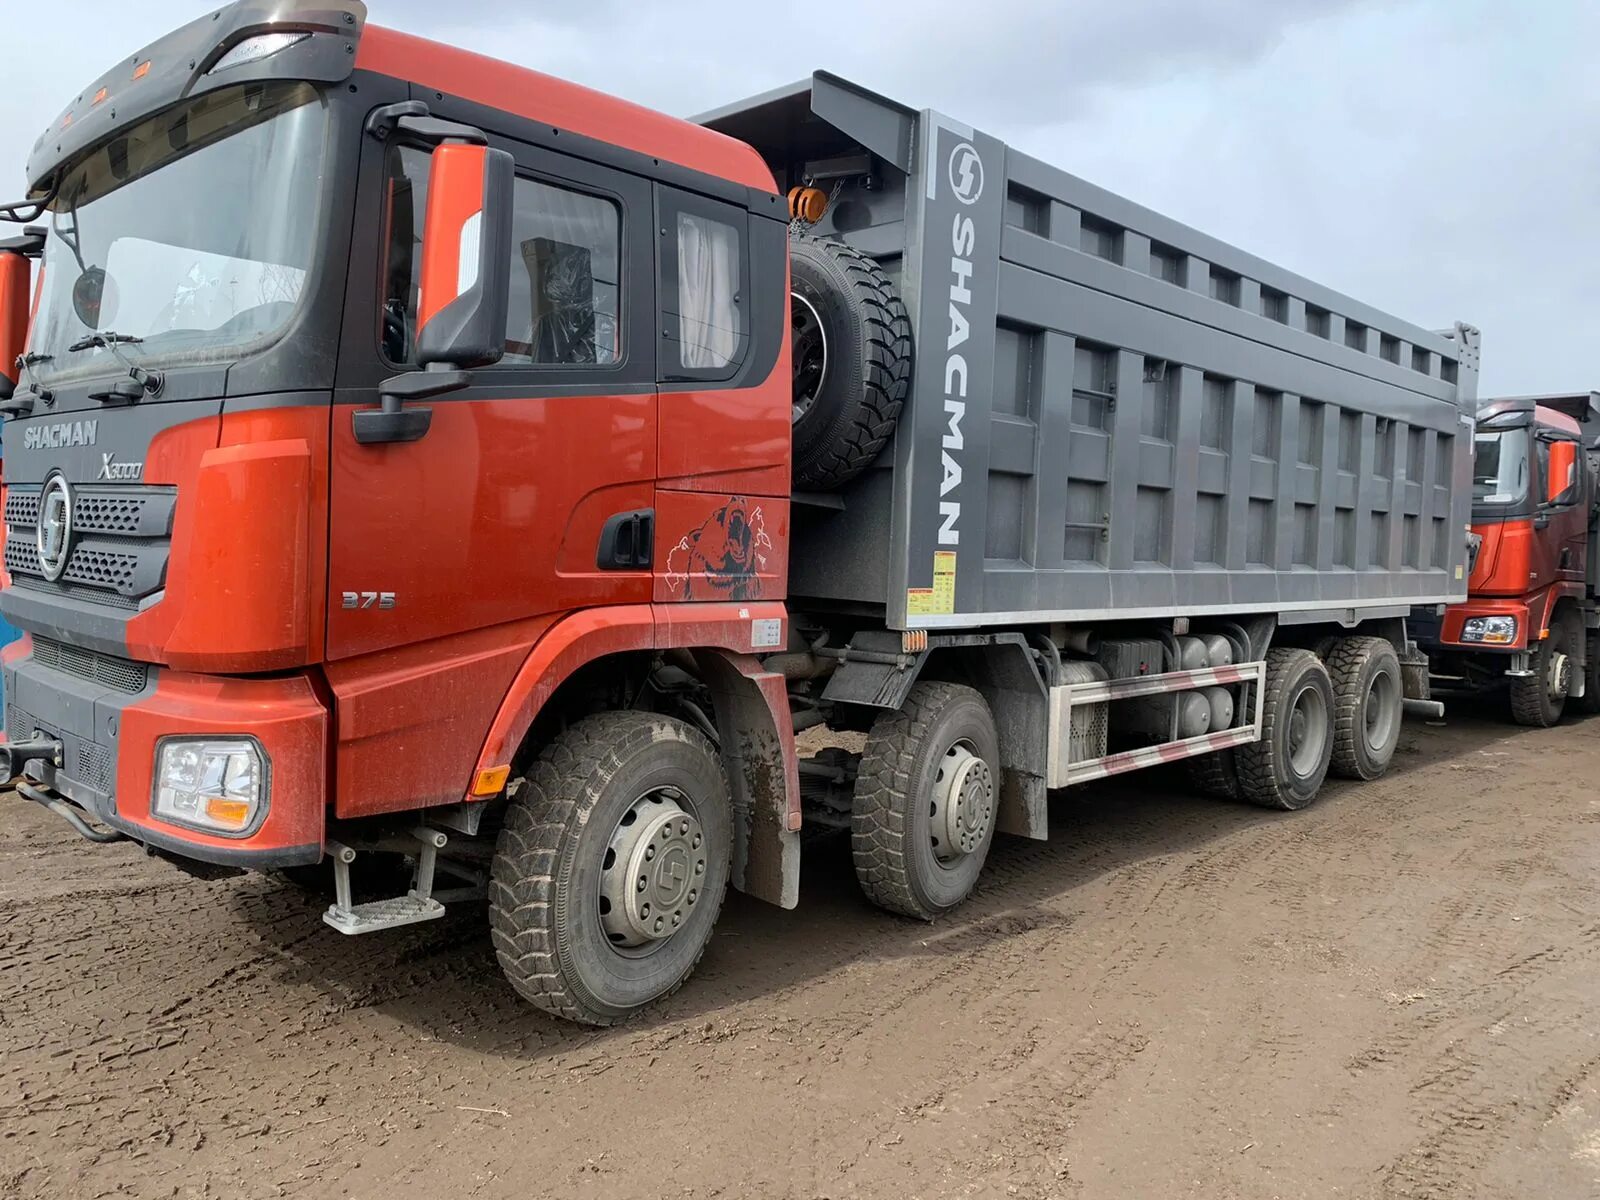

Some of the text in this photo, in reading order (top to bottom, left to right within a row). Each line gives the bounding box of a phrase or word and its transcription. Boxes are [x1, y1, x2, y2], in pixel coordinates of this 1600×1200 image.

[937, 212, 975, 545] SHACMAN
[24, 419, 98, 449] SHACMAN
[98, 452, 143, 480] X3000
[341, 591, 396, 609] 375
